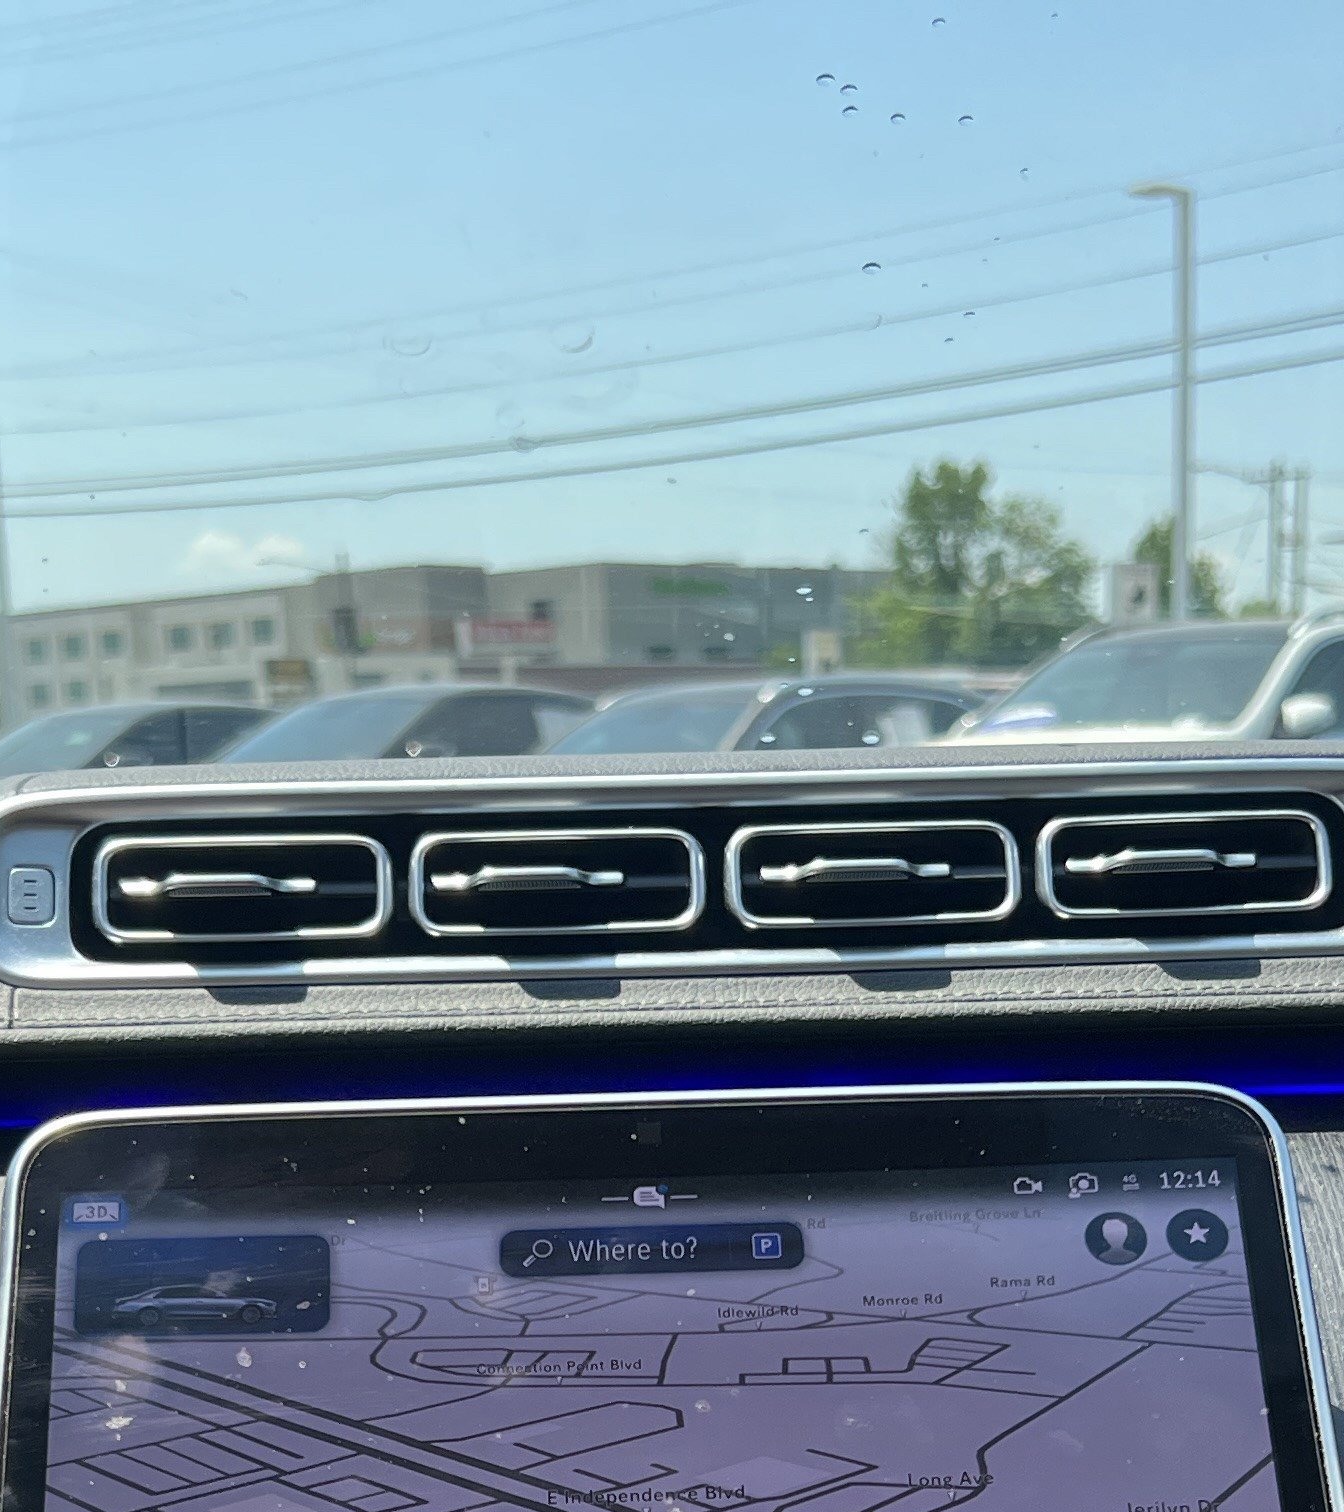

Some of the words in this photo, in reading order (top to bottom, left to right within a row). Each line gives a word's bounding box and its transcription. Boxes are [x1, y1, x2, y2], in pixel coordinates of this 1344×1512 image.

[1159, 1168, 1221, 1190] 12:14
[84, 1205, 108, 1221] 3D
[568, 1239, 651, 1262] Where
[661, 1236, 698, 1260] to?
[989, 1276, 1031, 1288] Rama
[1036, 1274, 1056, 1287] Rd
[862, 1295, 919, 1307] Monroe
[924, 1293, 944, 1305] Rd
[717, 1305, 775, 1318] Idlewild
[780, 1304, 799, 1317] Rd
[566, 1360, 605, 1373] Point
[610, 1358, 643, 1371] Blvd
[907, 1473, 952, 1488] Long
[960, 1472, 995, 1486] Ave
[547, 1489, 558, 1505] E
[564, 1487, 698, 1507] Independence
[705, 1485, 746, 1500] Blvd
